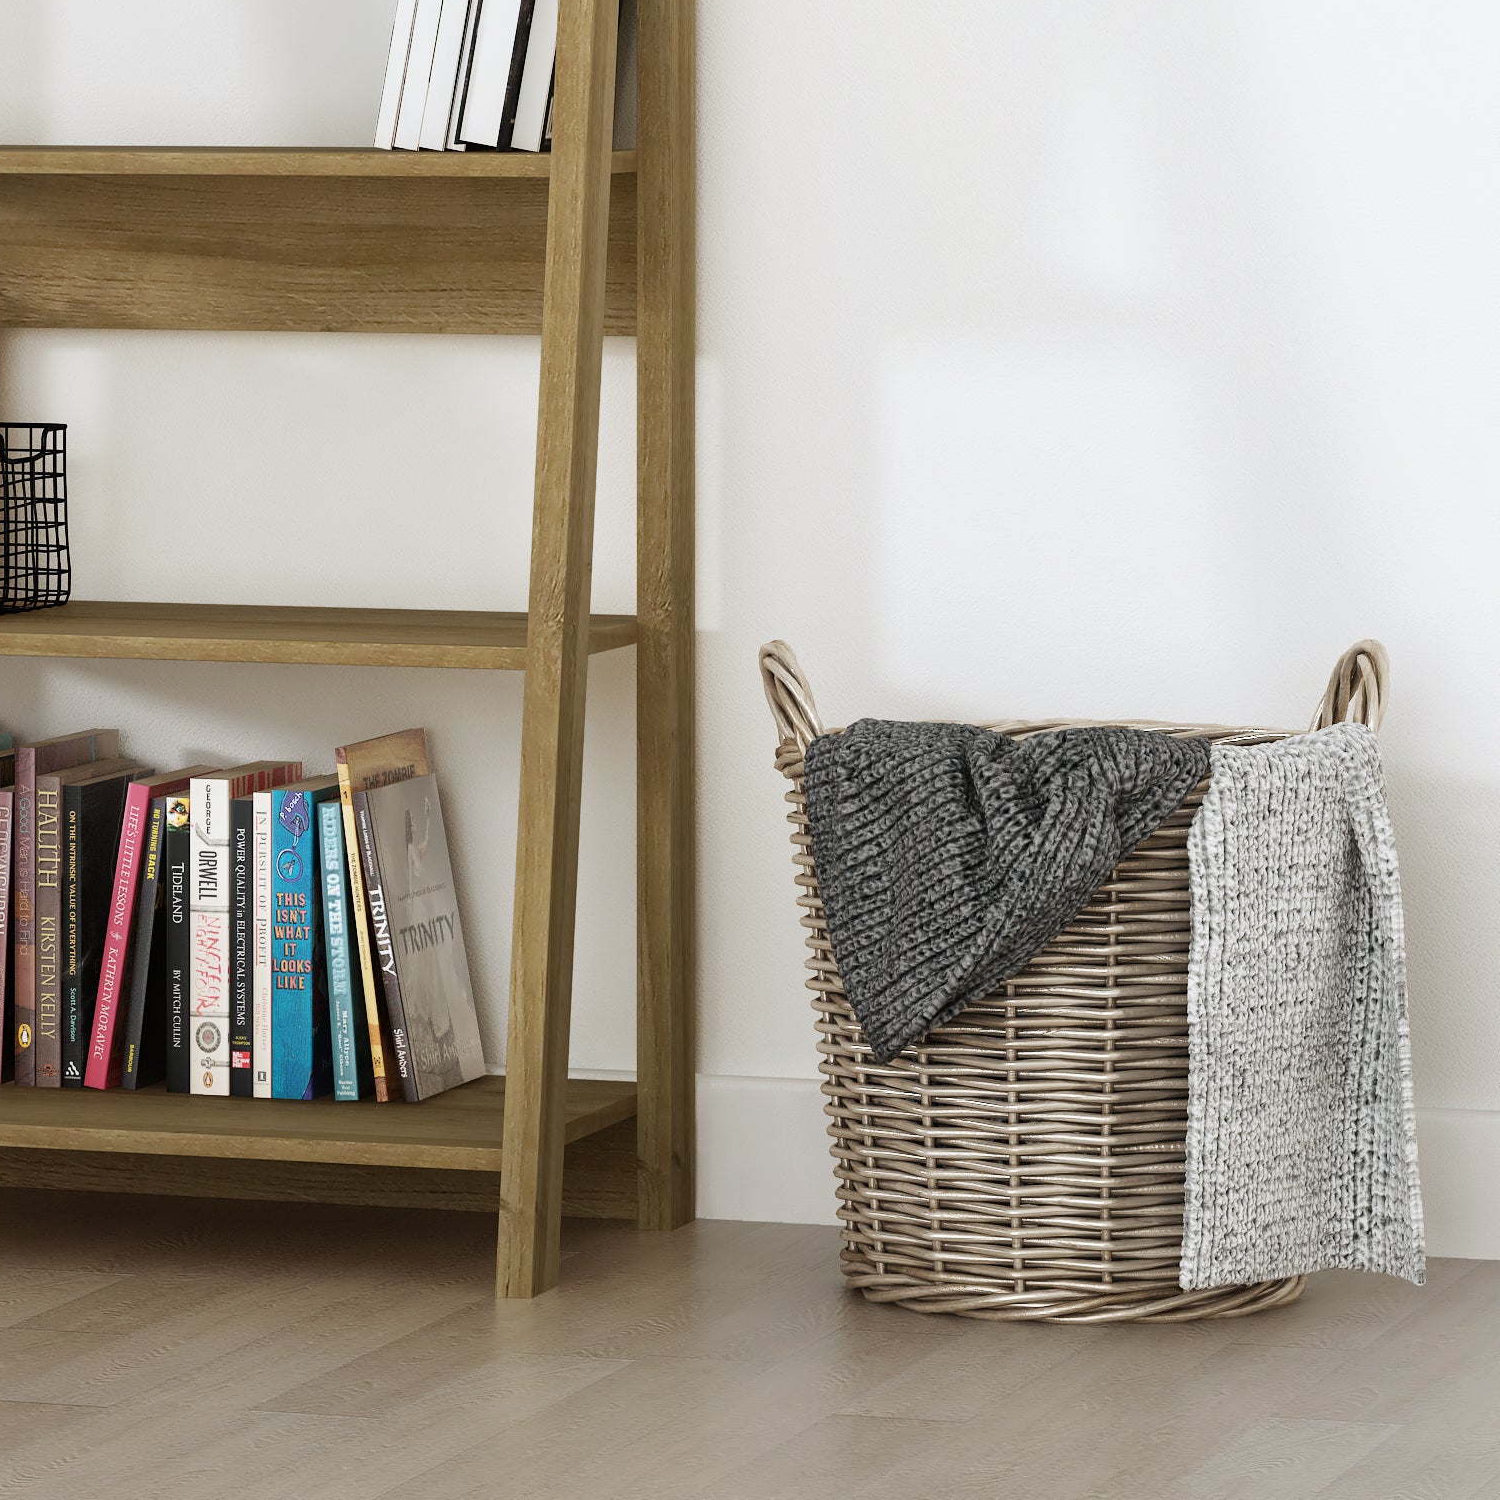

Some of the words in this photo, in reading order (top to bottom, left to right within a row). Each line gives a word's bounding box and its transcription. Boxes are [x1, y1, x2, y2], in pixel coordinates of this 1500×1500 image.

[19, 784, 30, 795] A
[362, 775, 380, 790] THE
[20, 798, 30, 834] Good
[70, 810, 76, 823] ON
[153, 808, 161, 819] NO
[285, 792, 302, 814] bosch
[127, 805, 140, 838] LIFE'S
[256, 811, 266, 826] IN
[20, 836, 30, 864] Man
[236, 828, 246, 862] POWER
[322, 807, 340, 871] RIDERS
[20, 866, 30, 878] is
[120, 838, 135, 878] LITTLE
[146, 854, 157, 880] BACK
[257, 832, 266, 890] PURSUIT
[198, 850, 218, 900] ORWELL
[235, 864, 246, 910] QUALITY
[326, 873, 341, 897] ON
[20, 881, 30, 912] Hard
[114, 879, 129, 926] LESSONS
[172, 862, 184, 924] TIDELAND
[258, 894, 266, 912] OF
[276, 892, 306, 907] THIS
[20, 914, 30, 927] to
[70, 912, 76, 922] OF
[236, 910, 246, 918] in
[276, 908, 307, 924] ISN'T
[328, 899, 343, 934] THE
[20, 930, 30, 956] Find
[258, 918, 267, 967] PROFIT
[274, 924, 311, 940] WHAT
[369, 884, 397, 977] TRINITY
[400, 914, 456, 956] TRINITY
[40, 916, 56, 986] KIRSTEN
[206, 916, 221, 1011] NINETEEN
[236, 920, 246, 978] ELECTRICAL
[284, 943, 296, 958] IT
[102, 946, 119, 1004] KATHRYN
[173, 970, 181, 981] BY
[274, 959, 312, 974] LOOKS
[276, 975, 306, 990] LIKE
[70, 1006, 76, 1014] A.
[173, 983, 181, 1014] MITCH
[236, 979, 246, 1026] SYSTEMS
[40, 993, 56, 1039] KELLY
[94, 1004, 110, 1060] MORAVEC
[173, 1015, 181, 1048] CULLIN
[394, 1028, 404, 1048] Shirl
[398, 1049, 408, 1078] Anders
